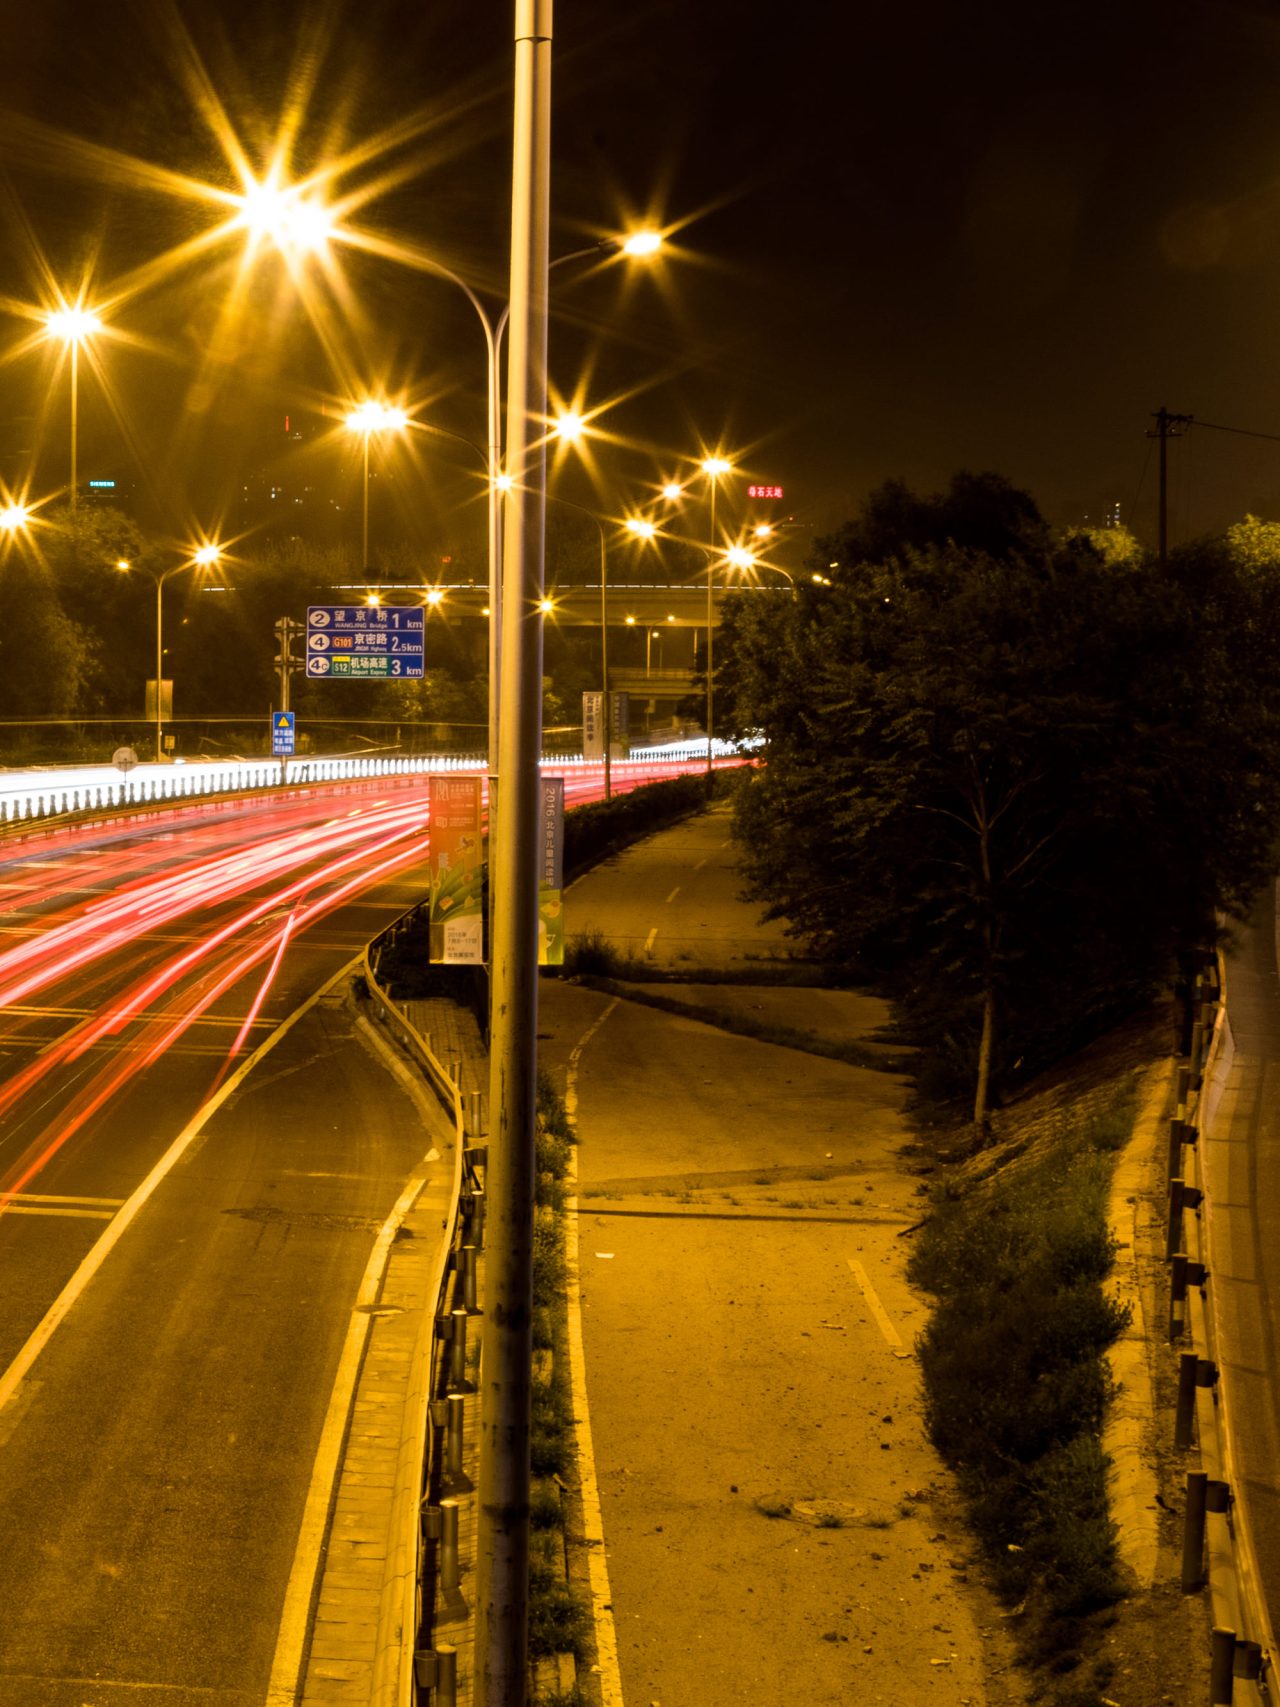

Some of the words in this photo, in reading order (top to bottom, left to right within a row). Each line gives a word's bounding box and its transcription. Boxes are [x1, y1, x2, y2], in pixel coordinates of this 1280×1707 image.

[314, 613, 325, 625] 2
[334, 610, 387, 621] 望京桥
[392, 613, 400, 628] 1
[407, 619, 422, 628] km
[314, 637, 325, 647] 4
[334, 638, 352, 648] G101
[354, 633, 387, 645] 京密路
[334, 662, 348, 672] S12
[351, 658, 388, 669] 机场高速
[392, 660, 401, 675] 3
[407, 666, 422, 675] km
[546, 788, 555, 816] 2016
